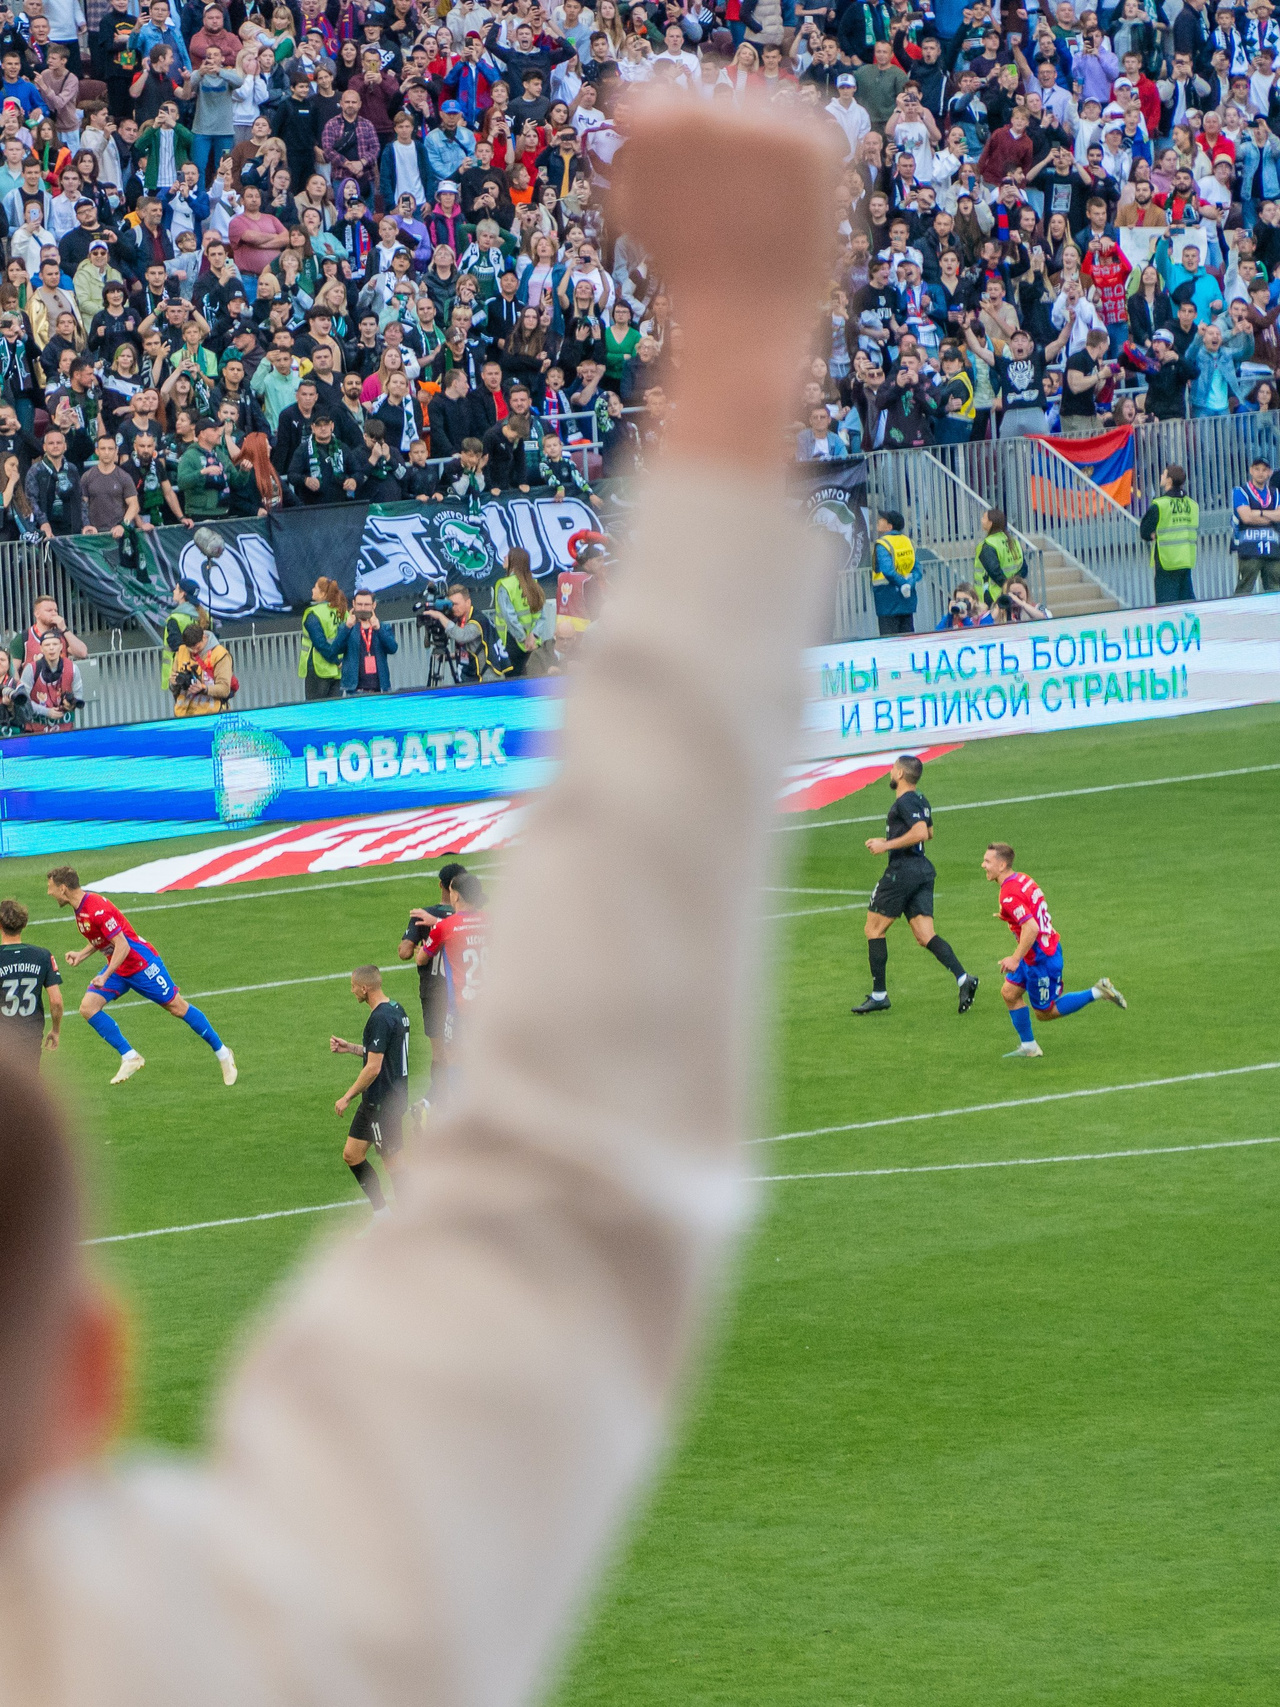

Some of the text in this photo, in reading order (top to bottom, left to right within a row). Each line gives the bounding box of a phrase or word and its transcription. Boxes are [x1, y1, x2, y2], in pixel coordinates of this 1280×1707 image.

[1258, 541, 1271, 555] 11
[822, 657, 879, 697] МЫ
[911, 643, 1019, 684] ЧАСТЬ
[1031, 612, 1202, 671] БОЛЬШОЙ
[841, 663, 1188, 738] И ВЕЛИКОЙ СТРАНЫ!
[305, 727, 507, 787] НОВАТЭК
[155, 975, 168, 988] 9
[1039, 986, 1050, 1001] 10
[0, 977, 38, 1017] 33
[371, 1121, 382, 1141] 11
